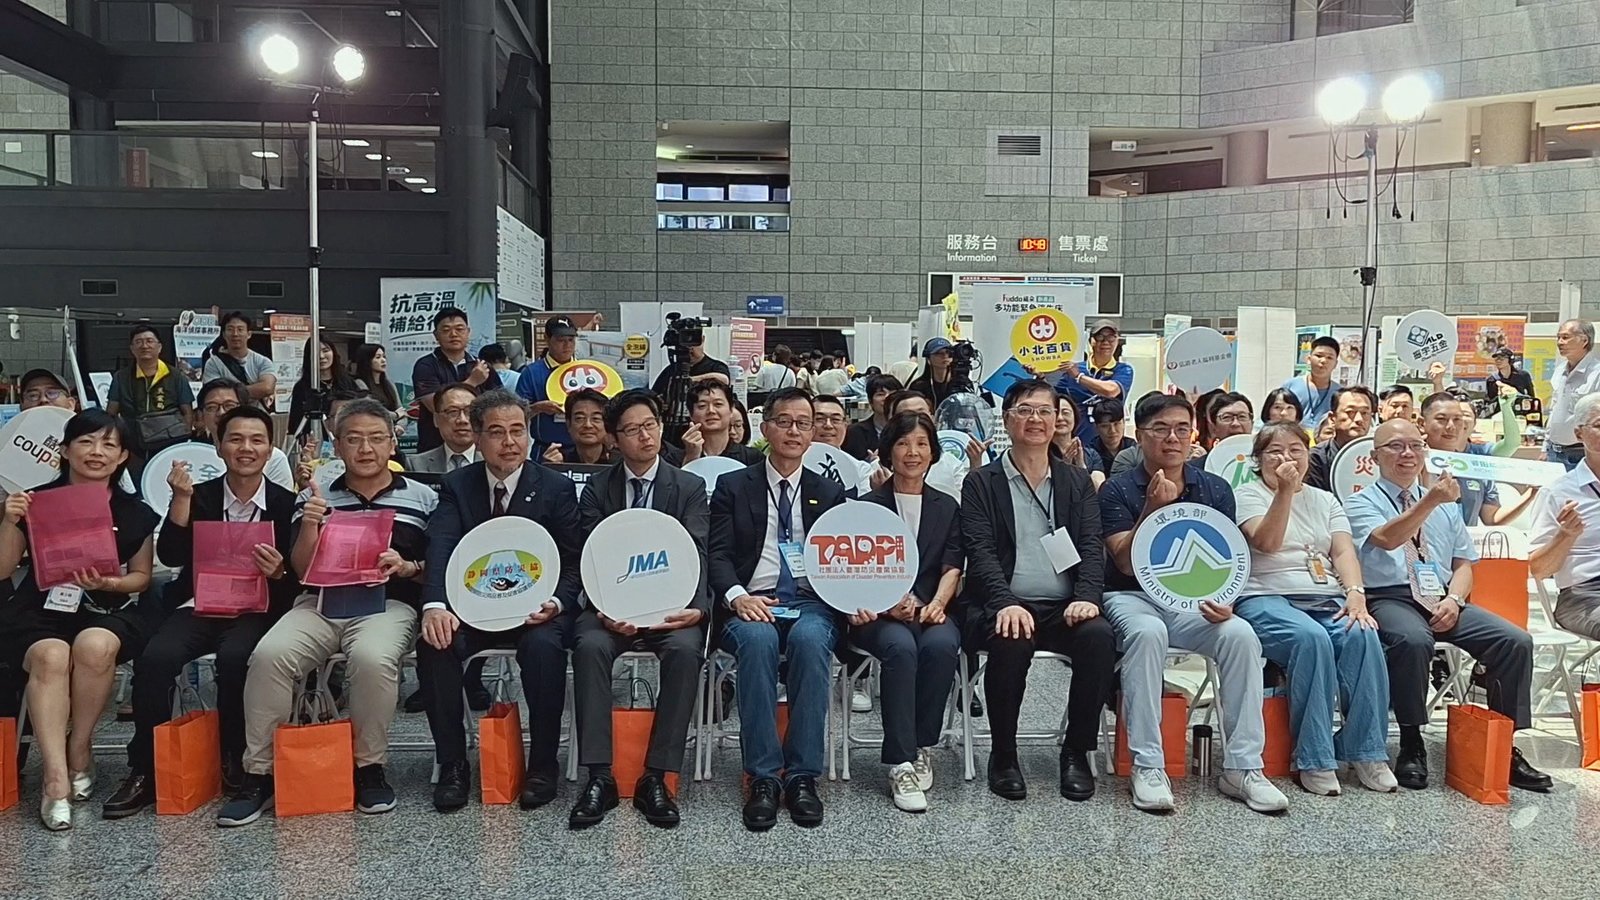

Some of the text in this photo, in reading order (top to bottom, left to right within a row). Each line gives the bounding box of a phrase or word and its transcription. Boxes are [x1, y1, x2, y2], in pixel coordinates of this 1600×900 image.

[946, 233, 998, 250] 服務台
[1021, 238, 1046, 250] 10:48
[1058, 235, 1109, 251] 售票處
[947, 252, 997, 262] Information
[1072, 253, 1098, 263] Ticket
[390, 291, 456, 314] 抗高溫
[1019, 342, 1072, 357] 小北百貨
[1154, 507, 1208, 526] 環境部
[616, 550, 669, 584] JMA
[1139, 565, 1177, 607] Ministry
[1180, 600, 1193, 609] of
